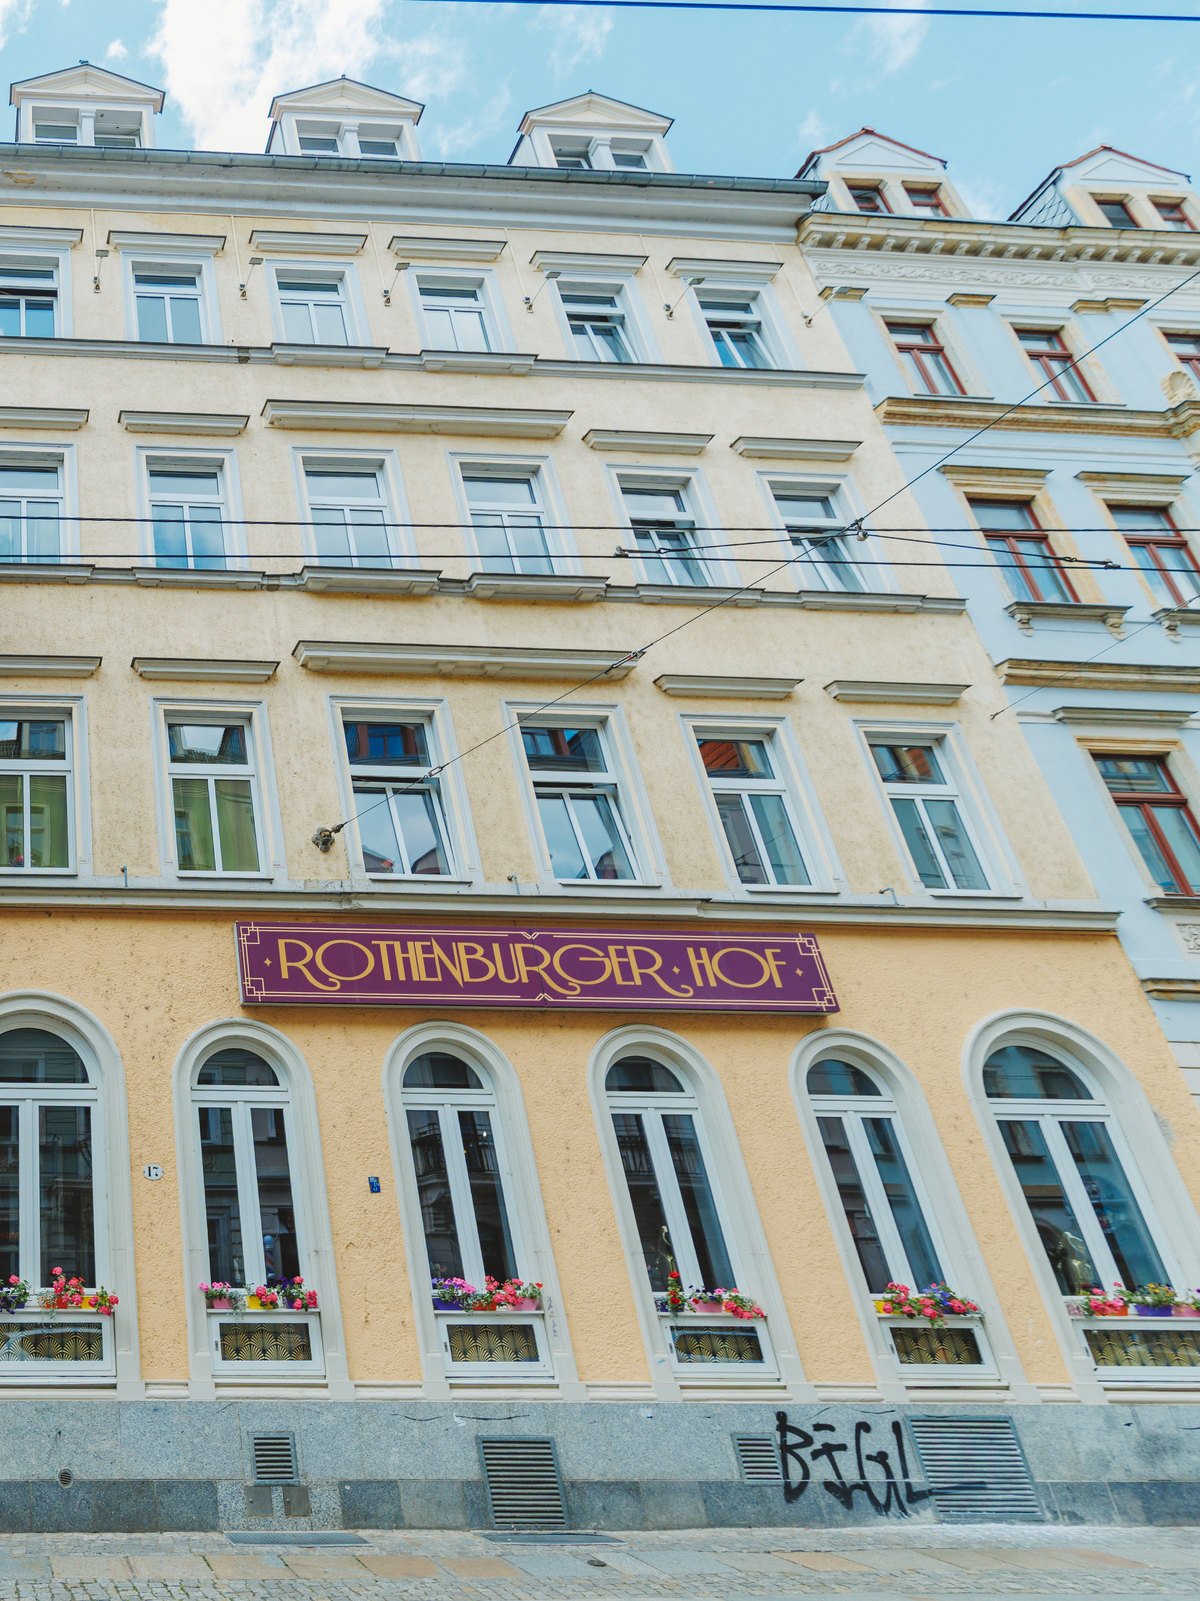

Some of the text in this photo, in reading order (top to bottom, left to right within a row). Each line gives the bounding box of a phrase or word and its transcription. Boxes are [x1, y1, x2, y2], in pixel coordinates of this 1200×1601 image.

[277, 936, 787, 998] ROTHENBURGER HOF
[147, 1166, 160, 1178] 17
